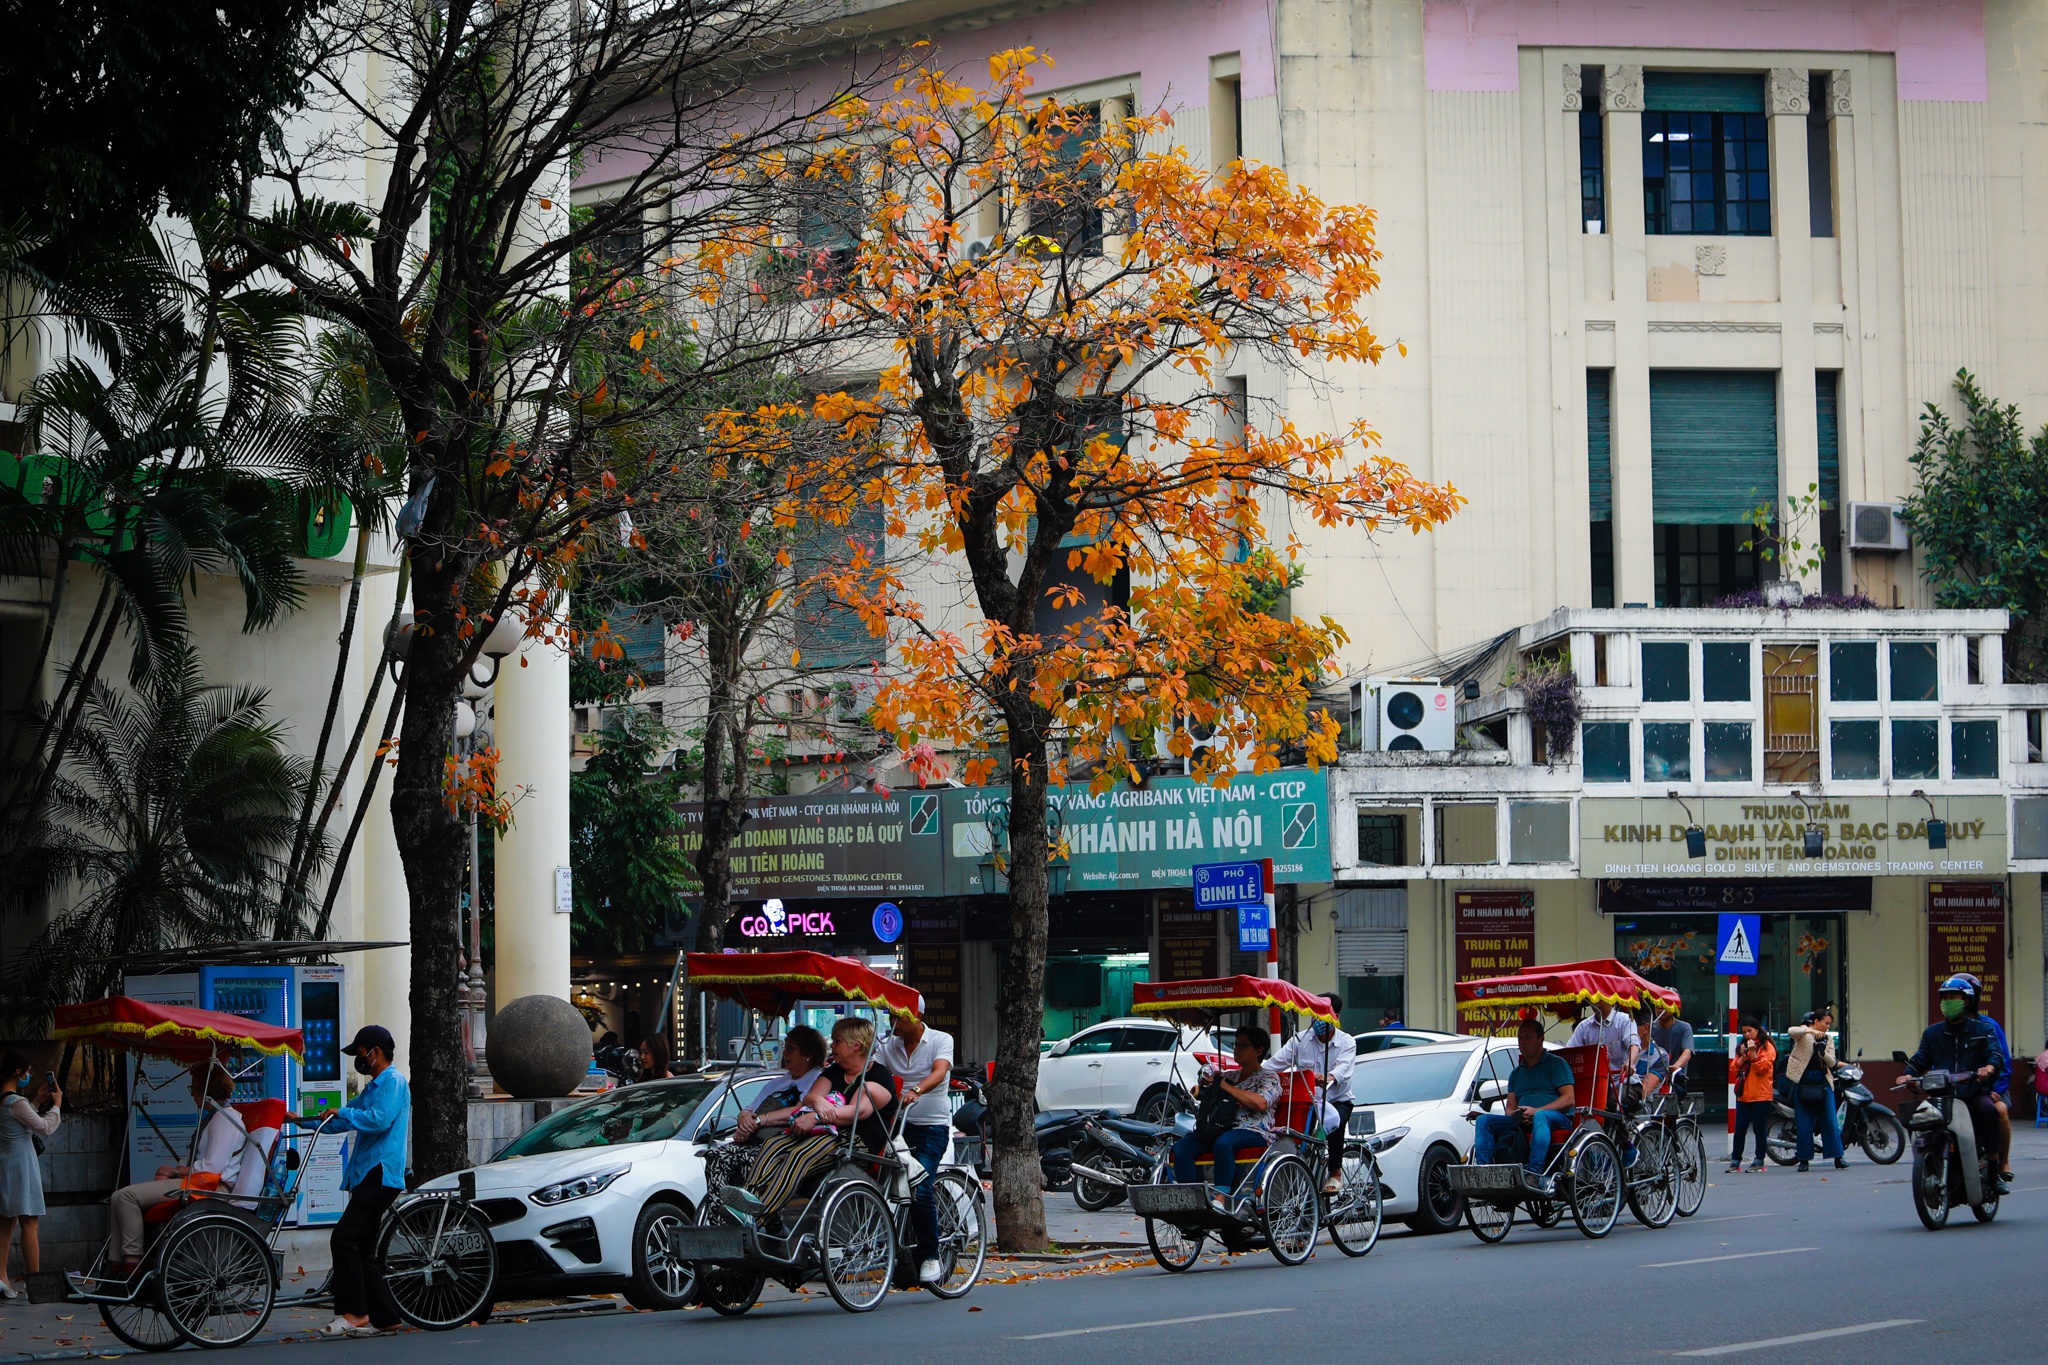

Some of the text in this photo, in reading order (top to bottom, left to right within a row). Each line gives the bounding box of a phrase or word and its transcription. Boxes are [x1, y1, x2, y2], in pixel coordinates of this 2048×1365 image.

[965, 791, 1000, 815] TỔNG
[1066, 790, 1105, 810] VÀNG
[1110, 789, 1183, 808] AGRIBANK
[1187, 784, 1217, 807] VIỆT
[1220, 785, 1255, 803] NAM
[1270, 781, 1305, 800] CTCP
[762, 806, 777, 821] VIỆT
[779, 806, 797, 817] NAM
[804, 804, 824, 816] CTCP
[826, 803, 839, 815] CHI
[841, 801, 869, 814] NHÁNH
[872, 800, 883, 813] HÀ
[885, 799, 900, 816] NỘI
[1742, 803, 1849, 820] TRUNG TÂM
[745, 828, 787, 848] DOANH
[790, 824, 824, 846] VÀNG
[828, 826, 853, 847] BẠC
[857, 822, 875, 843] ĐÁ
[878, 821, 904, 844] QUÝ
[1062, 816, 1156, 854] NHÁNH
[1166, 811, 1204, 850] HÀ
[1213, 809, 1261, 854] NỘI
[1604, 824, 1661, 842] KINH
[1670, 824, 1755, 844] DANH
[1841, 822, 1888, 844] BẠC
[1716, 843, 1876, 861] ĐINH TIÊN OÀNG
[750, 852, 778, 872] TIÊN
[782, 850, 824, 871] HOÀNG
[1605, 863, 1631, 873] DINH
[1635, 863, 1659, 873] TIEN
[1664, 863, 1702, 873] HOANG
[1706, 863, 1736, 873] GOLD
[1788, 862, 1810, 872] AND
[1813, 861, 1881, 872] GEMSTONES
[1886, 861, 1934, 871] TRADING
[1940, 860, 1984, 870] CENTER
[735, 872, 902, 885] SILVER AND GEMSTONES TRADING CENTER
[1083, 870, 1107, 881] Website:
[1109, 870, 1138, 881] Ajc.com.vn
[1151, 868, 1166, 880] ĐIỆN
[1167, 867, 1186, 879] THOẠI:
[1223, 866, 1244, 879] PHỐ
[817, 885, 829, 893] ĐIỆN
[1201, 877, 1256, 902] ĐINH LỄ
[1647, 886, 1660, 894] Kim
[1934, 896, 2000, 909] CHI NHÁNH HÀ NỘI
[1163, 911, 1212, 923] CHI NHÁNH HÀ NỘI
[1251, 910, 1261, 920] PHỐ
[1463, 906, 1529, 918] CHI NHÁNH HÀ NỘI
[787, 911, 836, 934] PICK
[912, 919, 921, 928] CHI
[922, 918, 939, 928] NHÁNH
[940, 918, 947, 928] HÀ
[1976, 925, 1996, 933] CÔNG
[1242, 928, 1250, 942] ĐINH
[1258, 925, 1268, 942] HOÀNG
[1194, 939, 1211, 947] CÔNG
[1464, 937, 1528, 951] TRUNG TÂM
[1964, 944, 1985, 953] CÔNG
[914, 948, 957, 960] TRUNG TÂM
[1174, 958, 1202, 967] GIA CÔNG
[1471, 954, 1523, 969] MUA BÁN
[1951, 963, 1983, 973] LÀM MỚI
[918, 966, 935, 976] MUA
[1935, 974, 1951, 983] HÀN
[1984, 973, 1999, 982] SỨC
